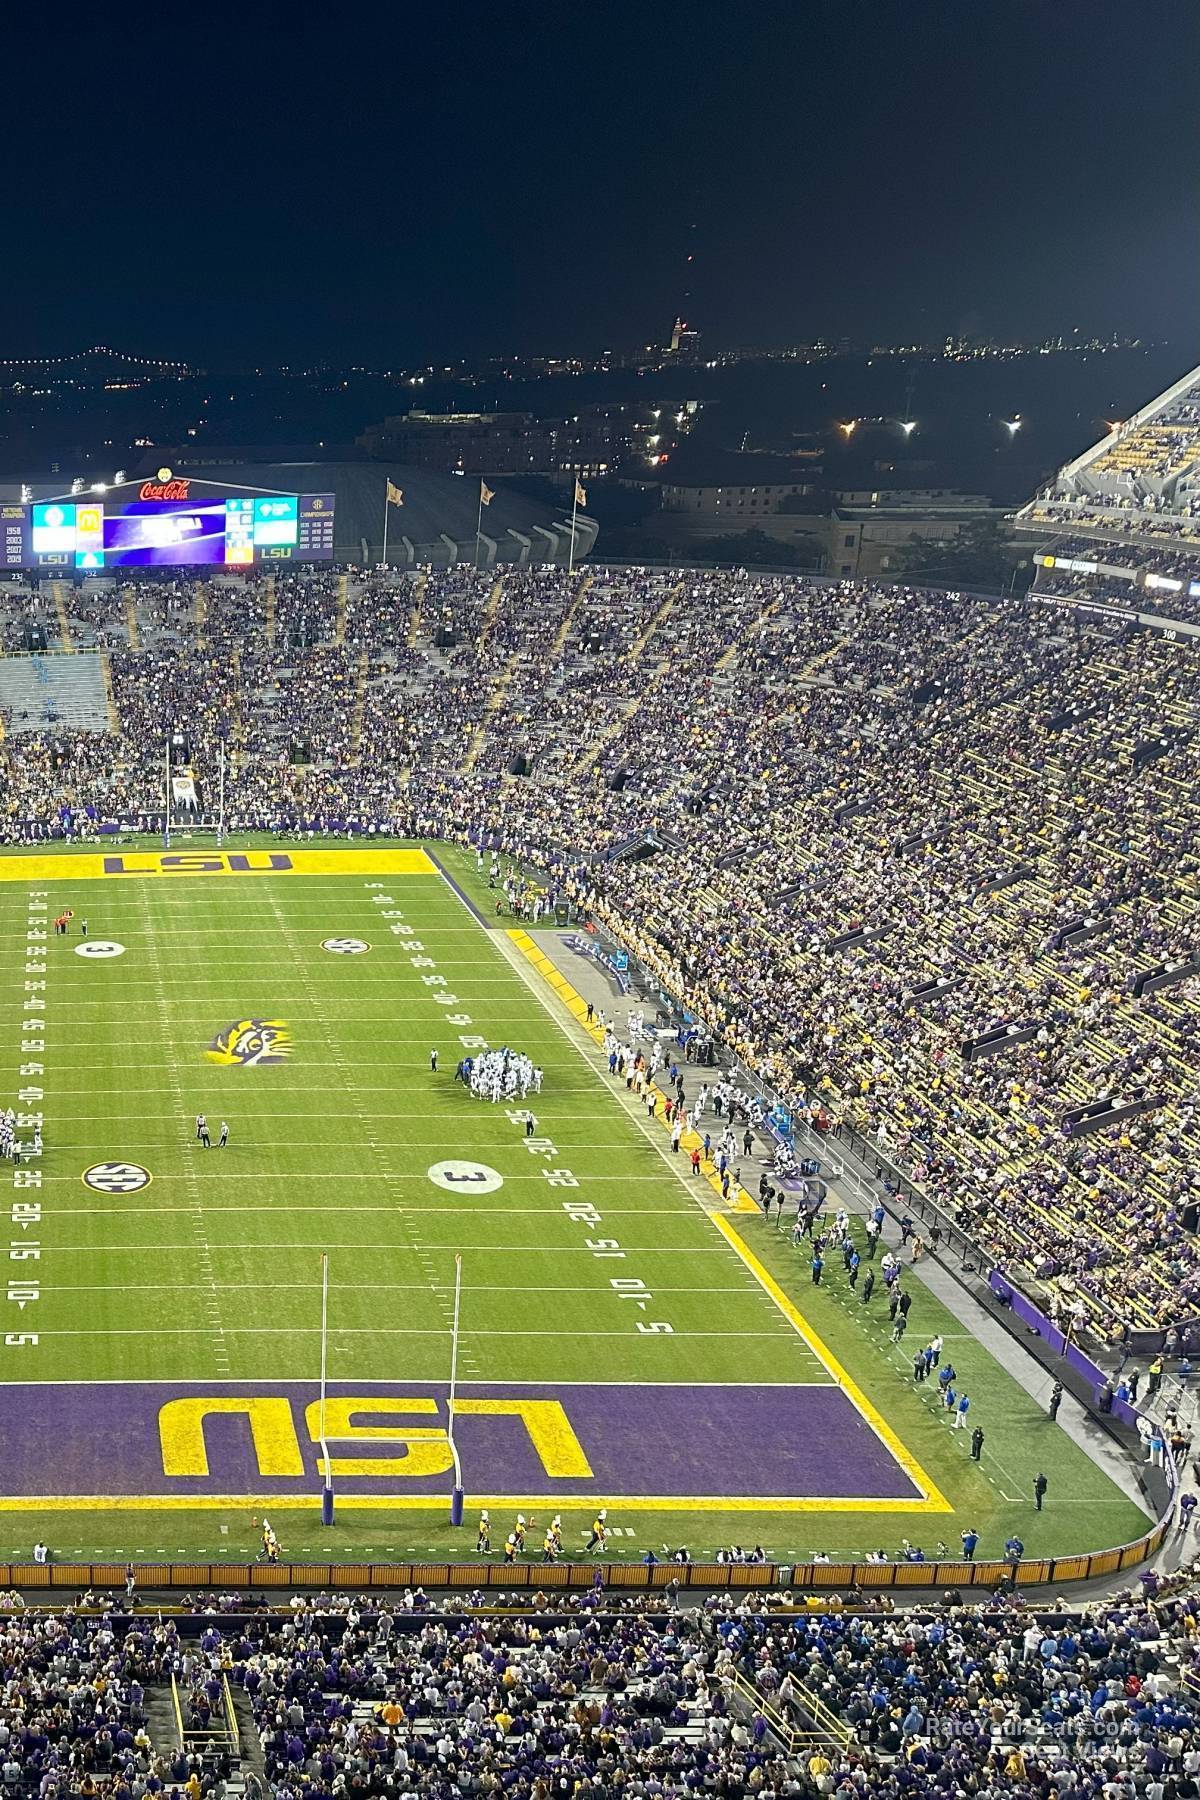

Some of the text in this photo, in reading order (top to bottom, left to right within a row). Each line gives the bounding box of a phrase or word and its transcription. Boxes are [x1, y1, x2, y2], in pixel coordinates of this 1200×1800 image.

[140, 481, 190, 500] Coca-Cola
[6, 527, 21, 535] 1958
[6, 546, 21, 554] 2007
[261, 548, 291, 558] LSU
[7, 555, 21, 563] 2019
[39, 554, 68, 564] LSU
[945, 592, 960, 600] 242
[1163, 629, 1176, 640] 300
[104, 855, 293, 873] LSU
[23, 1019, 45, 1030] 45
[445, 1014, 472, 1025] 45
[21, 1040, 44, 1051] 50
[459, 1036, 488, 1048] 50
[20, 1062, 44, 1075] 45
[19, 1087, 43, 1100] 40
[17, 1112, 43, 1127] 35
[522, 1137, 559, 1155] 30
[13, 1171, 42, 1188] 25
[443, 1171, 486, 1182] 3
[542, 1168, 580, 1187] 25
[12, 1203, 41, 1222] 20
[562, 1202, 602, 1222] 20
[9, 1241, 40, 1259] 15
[585, 1238, 626, 1258] 15
[7, 1280, 40, 1300] 10
[609, 1278, 652, 1299] 10
[635, 1321, 674, 1333] 5
[5, 1334, 38, 1345] 5
[158, 1398, 594, 1478] LSU
